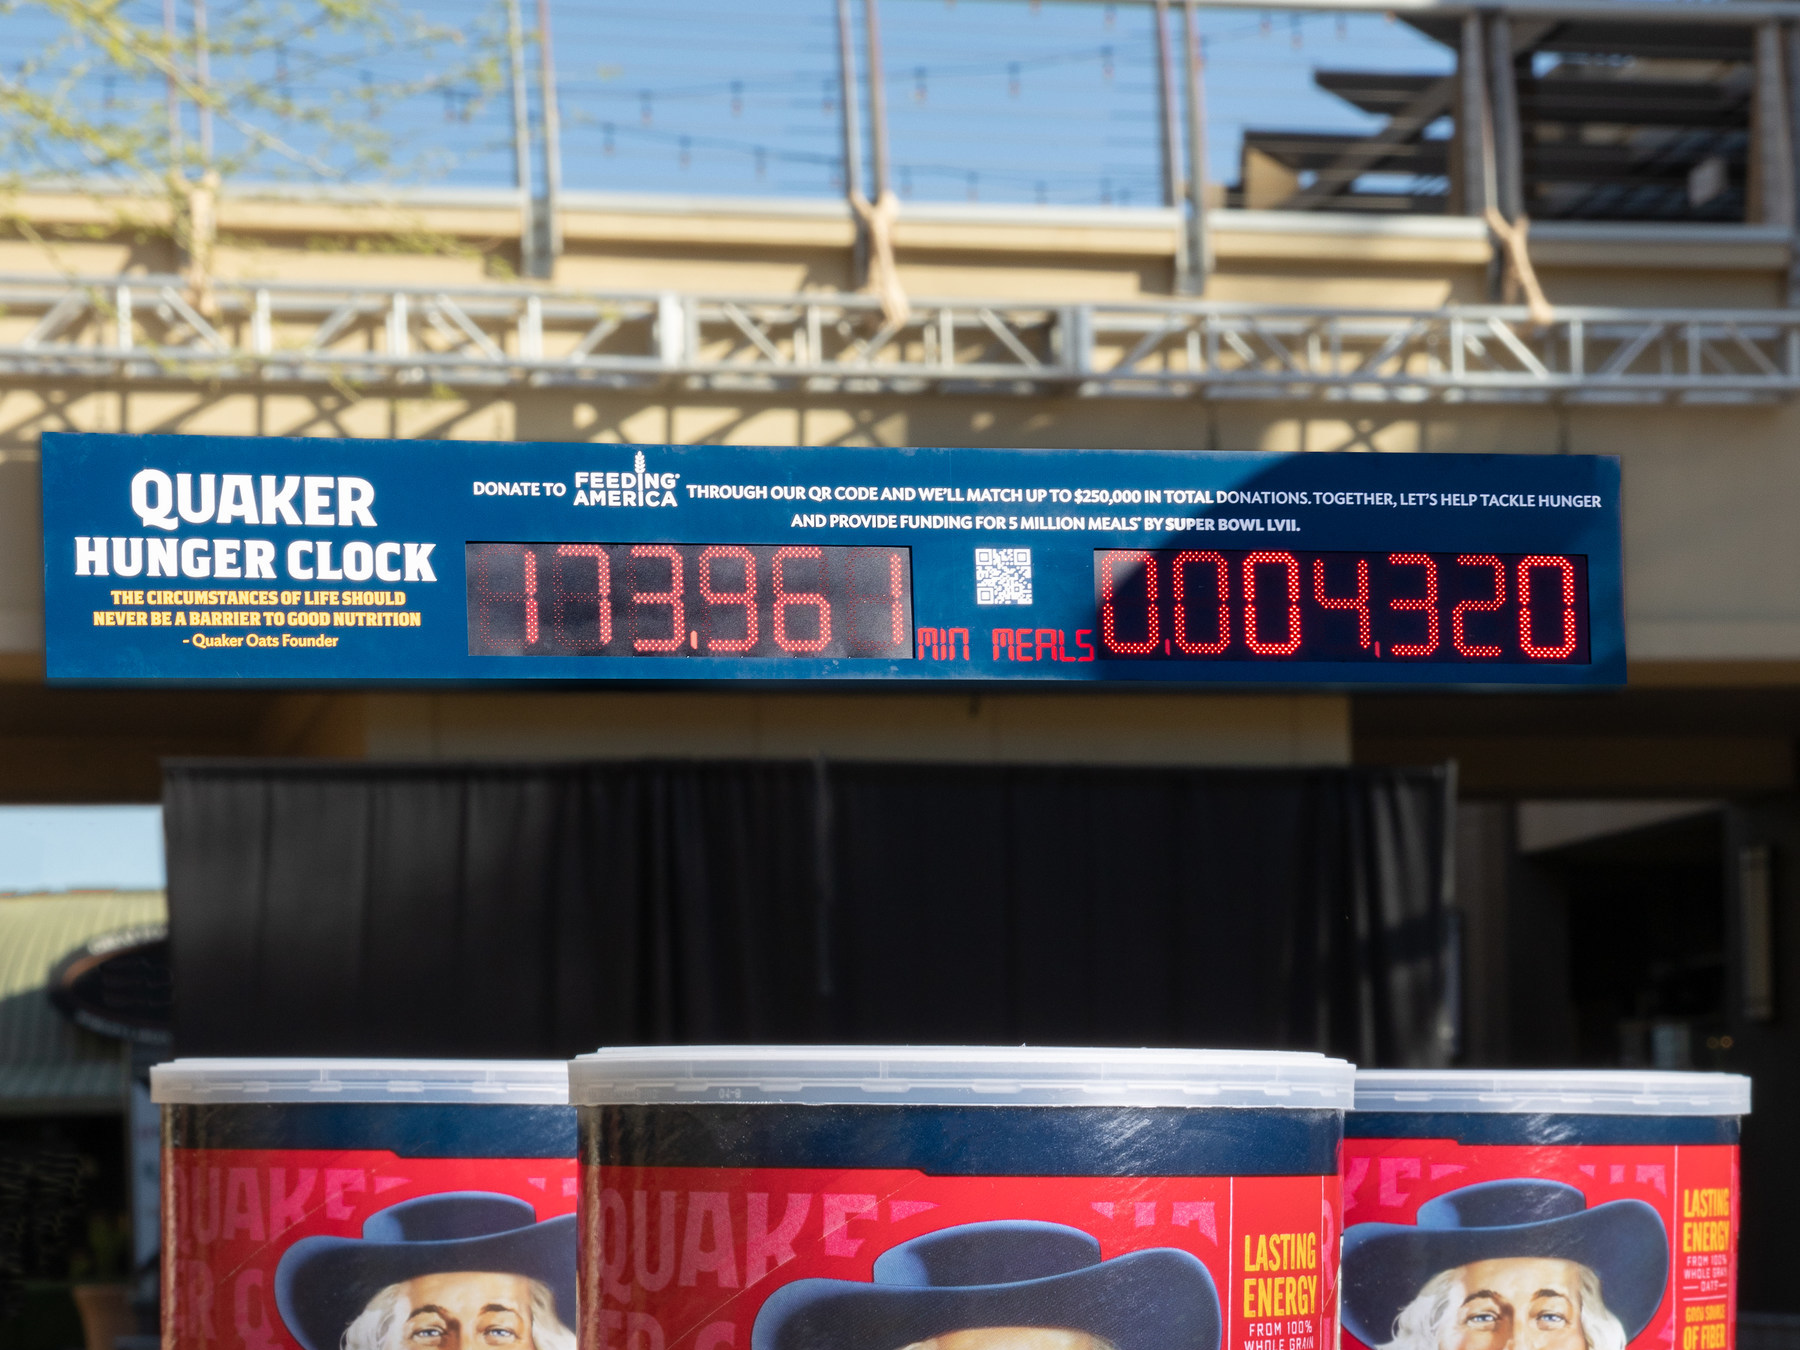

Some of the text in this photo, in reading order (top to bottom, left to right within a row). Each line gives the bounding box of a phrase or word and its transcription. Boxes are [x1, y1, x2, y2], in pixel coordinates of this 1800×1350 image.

[473, 481, 567, 497] DONATE TO
[575, 471, 680, 490] FEEDING
[130, 468, 378, 531] QUAKER
[573, 490, 678, 507] AMERICA
[686, 484, 1602, 508] THROUGH OUR QR CODE AND WE'LL MATCH UP TO $250,000 IN TOTAL DONATIONS. TOGETHER, LET'S HELP TACKLE HUNGER
[790, 514, 827, 528] AND
[829, 514, 897, 529] PROVIDE
[900, 515, 972, 529] FUNDING
[975, 515, 1006, 530] FOR
[1008, 516, 1018, 530] 5
[1020, 516, 1085, 531] MILLION
[1143, 517, 1164, 531] BY
[1165, 517, 1216, 531] SUPER
[1218, 518, 1264, 532] BOWL
[1266, 518, 1301, 532] LVII.
[74, 536, 438, 582] HUNGER CLOCK
[111, 590, 407, 606] THE CIRCUMSTANCES OF LIFE SHOULD
[93, 611, 422, 627] NEVER BE A BARRIER TO GOOD NUTRITION
[191, 633, 339, 649] Quaker Oats Founder
[917, 627, 1095, 662] MIN MEALS
[174, 1167, 412, 1254] QUAKE
[1683, 1188, 1730, 1218] LASTING
[599, 1188, 940, 1304] QUAKE
[1683, 1221, 1730, 1253] ENERGY
[1244, 1232, 1316, 1272] LASTING
[1243, 1275, 1318, 1318] ENERGY
[1249, 1319, 1313, 1337] FROM 100%
[1700, 1323, 1726, 1350] FIBER
[1289, 1336, 1314, 1350] GRAIN
